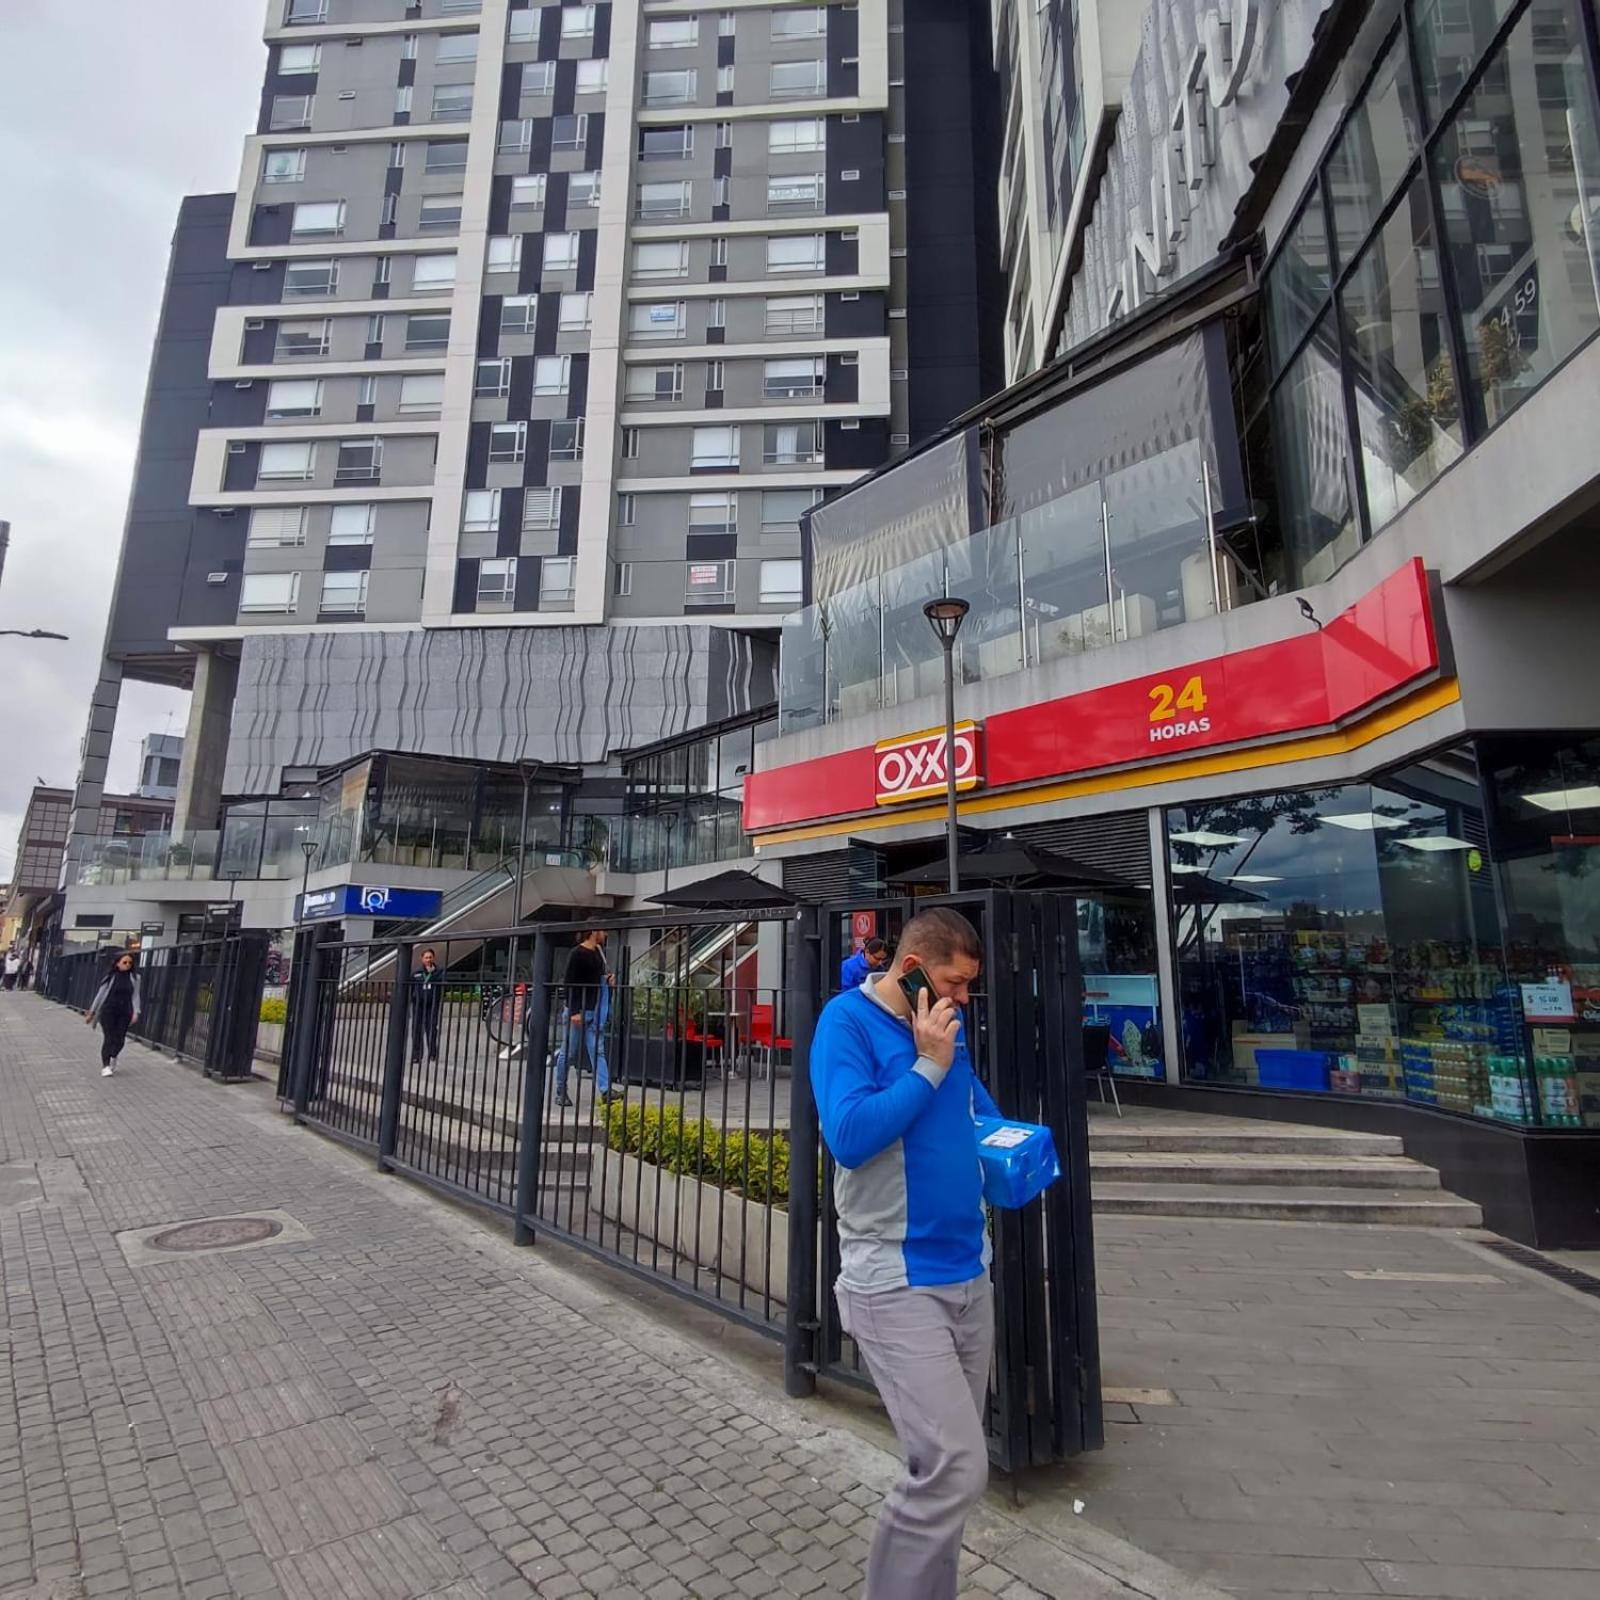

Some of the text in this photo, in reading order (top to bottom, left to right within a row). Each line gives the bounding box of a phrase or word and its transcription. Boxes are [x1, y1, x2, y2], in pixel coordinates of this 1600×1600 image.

[1149, 676, 1208, 722] 24
[1149, 717, 1211, 742] HORAS
[878, 733, 974, 792] OXXO
